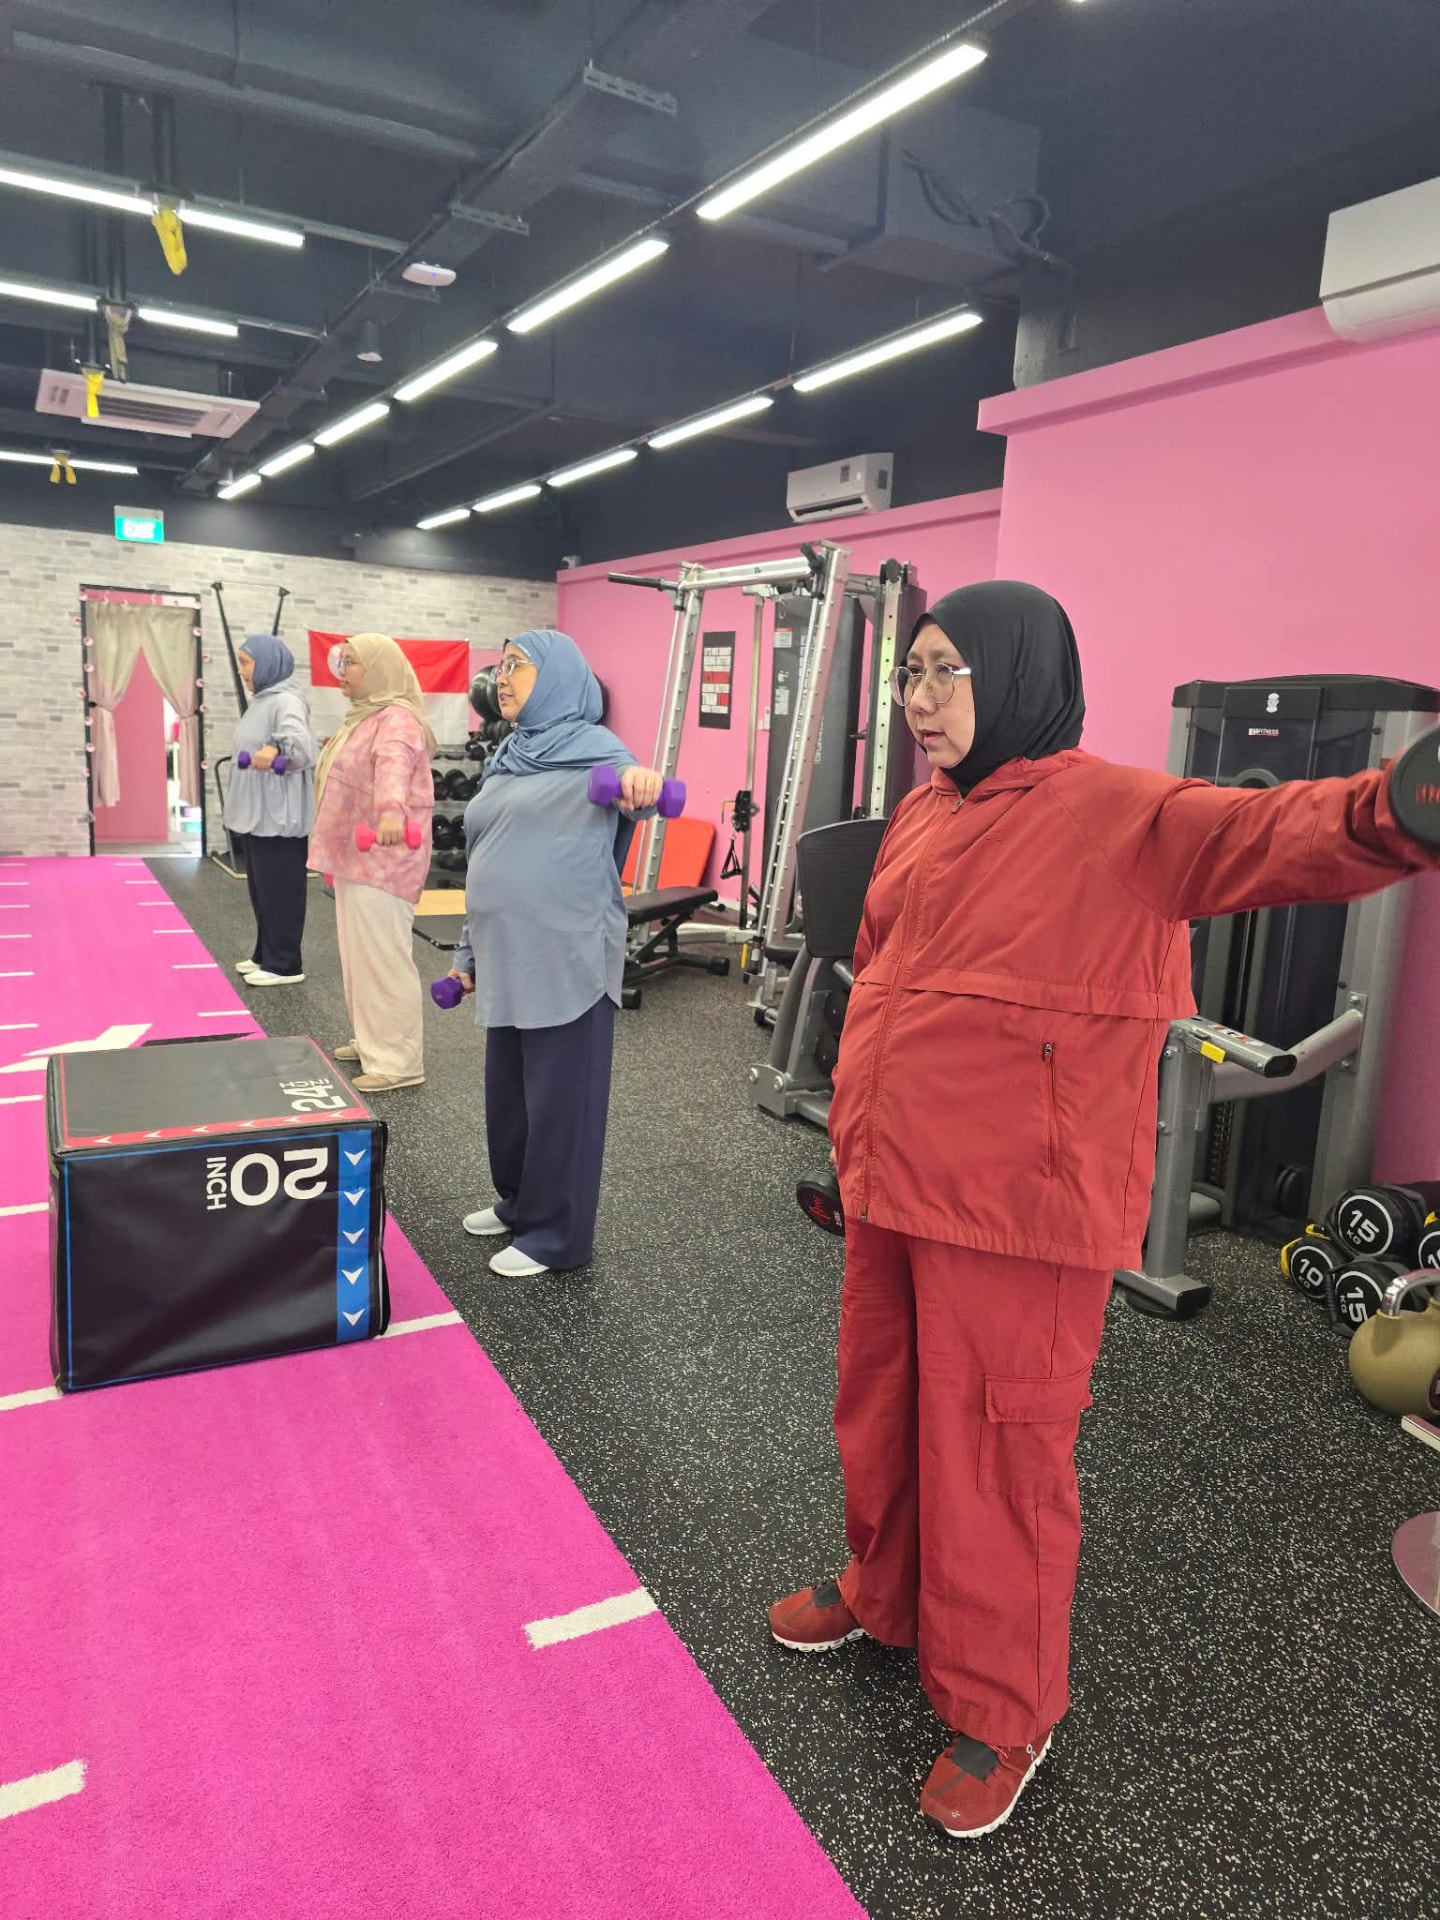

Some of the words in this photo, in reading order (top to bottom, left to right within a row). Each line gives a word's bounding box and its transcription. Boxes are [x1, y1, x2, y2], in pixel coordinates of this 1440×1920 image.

[123, 520, 156, 539] EXIT
[279, 1078, 330, 1089] INCH
[283, 1085, 347, 1112] 24
[206, 1156, 227, 1210] INCH
[231, 1147, 328, 1206] 20
[1346, 1229, 1362, 1245] KG
[1350, 1209, 1380, 1243] 15
[1299, 1258, 1324, 1287] 10
[1340, 1295, 1347, 1313] KG
[1346, 1286, 1368, 1322] 15
